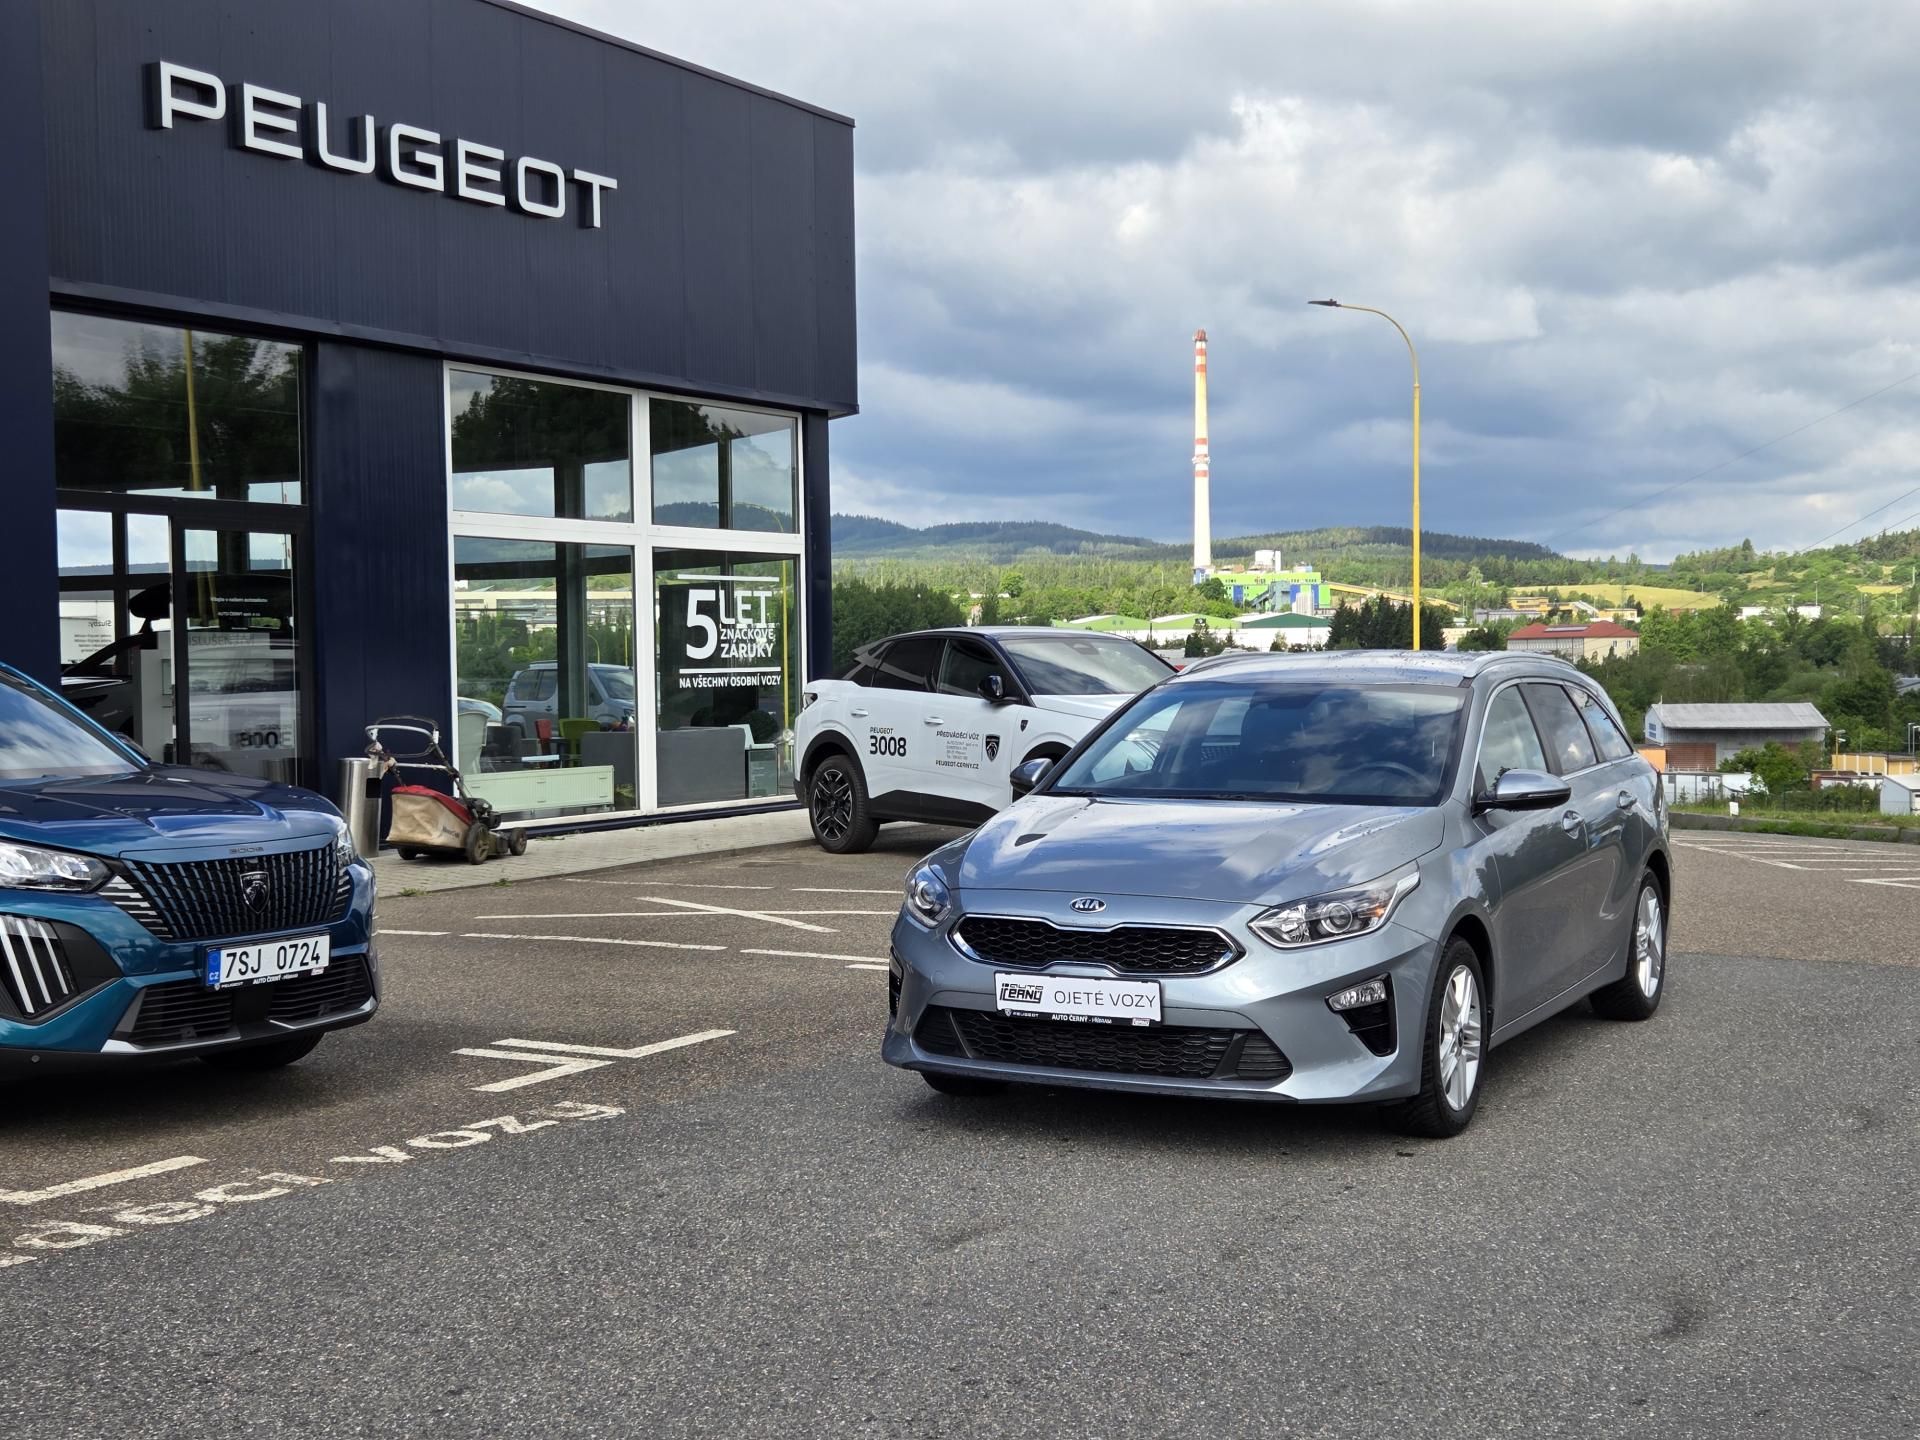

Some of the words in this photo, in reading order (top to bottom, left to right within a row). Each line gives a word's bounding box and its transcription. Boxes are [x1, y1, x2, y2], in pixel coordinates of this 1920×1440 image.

[153, 60, 618, 230] PEUGEOT
[686, 589, 718, 660] 5
[719, 589, 773, 626] LET
[720, 641, 774, 658] ZÁRUKY
[679, 677, 691, 688] NA
[692, 675, 729, 688] VŠECHNY
[730, 673, 760, 686] OSOBNÍ
[761, 675, 781, 686] VOZY
[869, 726, 894, 735] PEUGEOT
[869, 735, 907, 757] 3008
[1074, 899, 1100, 909] KIA
[225, 948, 262, 978] 7SJ
[276, 940, 320, 970] 0724
[208, 971, 219, 981] CZ
[1054, 990, 1105, 1006] OJETÉ
[1109, 993, 1156, 1008] VOZY
[1051, 1014, 1069, 1022] AUTO
